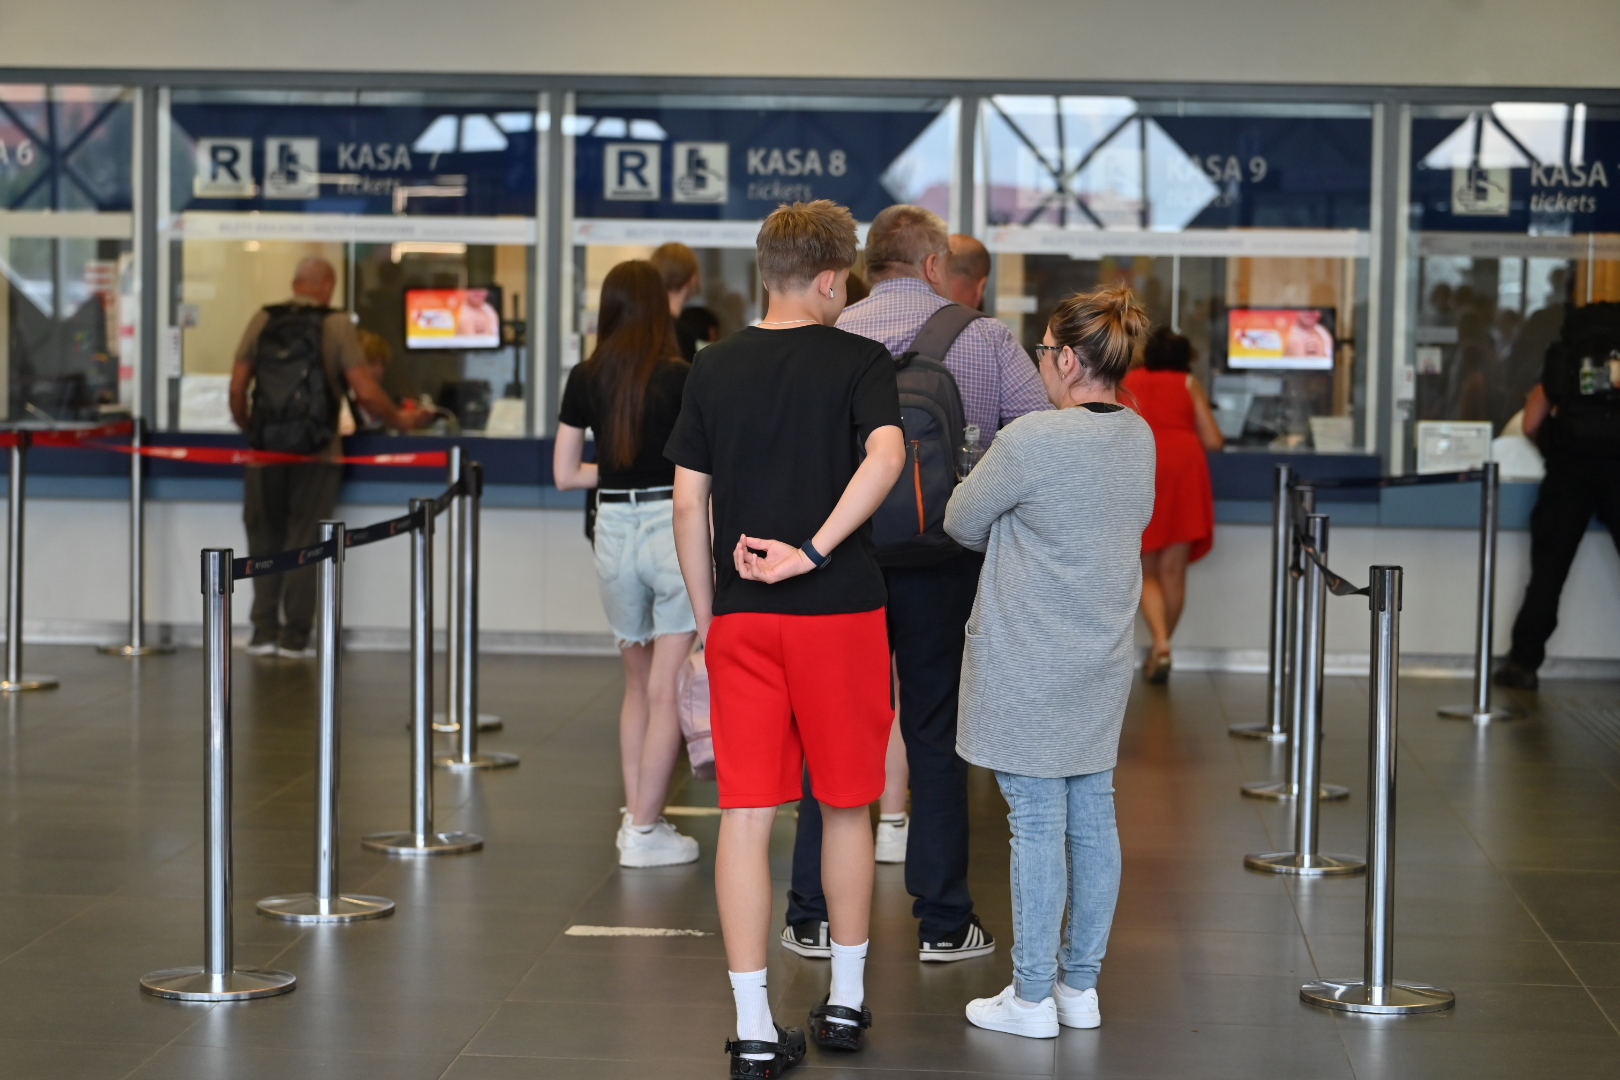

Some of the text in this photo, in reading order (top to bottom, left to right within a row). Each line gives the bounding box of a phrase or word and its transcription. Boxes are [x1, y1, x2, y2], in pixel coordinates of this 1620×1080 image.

[16, 138, 33, 167] 6
[210, 145, 241, 182] R
[337, 142, 412, 171] KASA
[746, 148, 847, 177] KASA 8
[618, 150, 649, 187] R
[1248, 154, 1269, 183] 9
[1530, 160, 1609, 188] KASA
[746, 180, 812, 201] tickets
[1530, 191, 1597, 213] tickets
